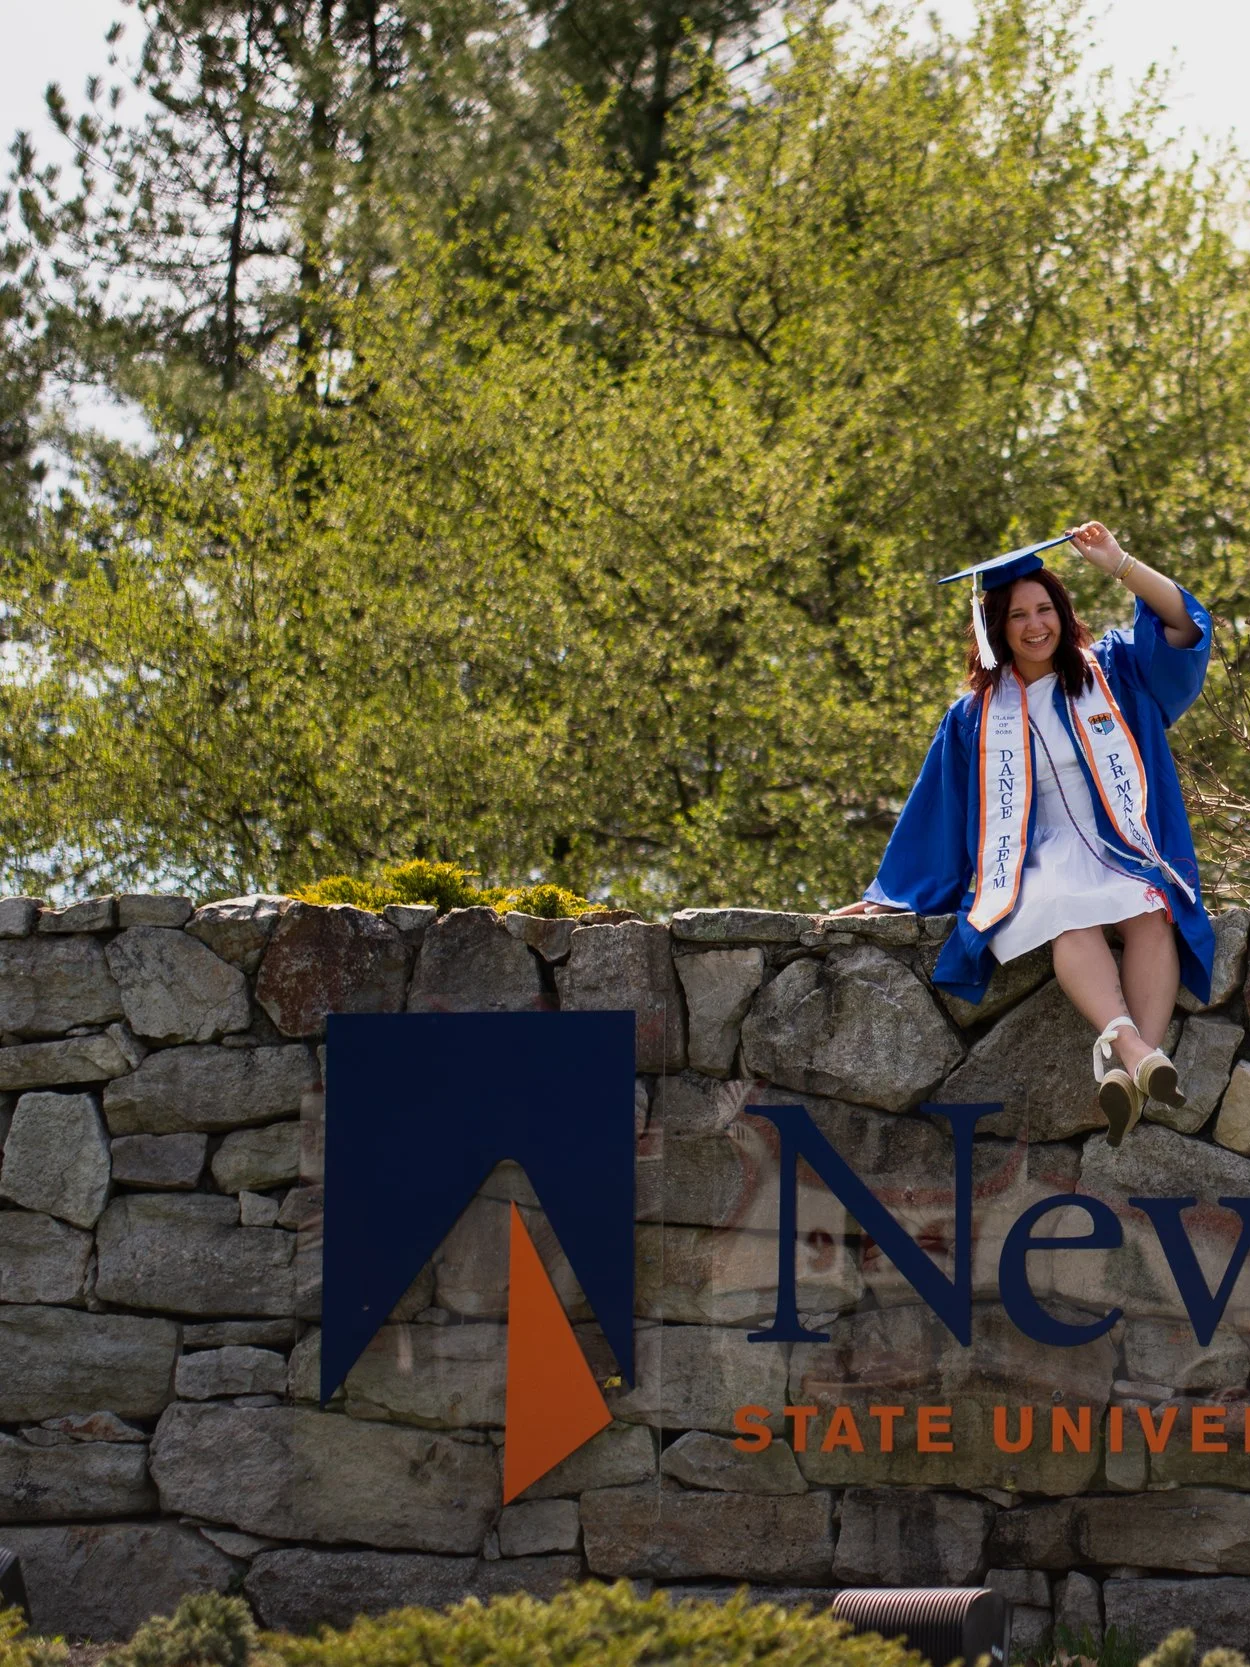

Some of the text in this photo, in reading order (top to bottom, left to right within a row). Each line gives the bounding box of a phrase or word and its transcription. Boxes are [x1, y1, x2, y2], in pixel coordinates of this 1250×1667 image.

[1106, 752, 1127, 781] PR
[991, 749, 1015, 890] DANCE TEAM
[732, 1404, 954, 1454] STATE
